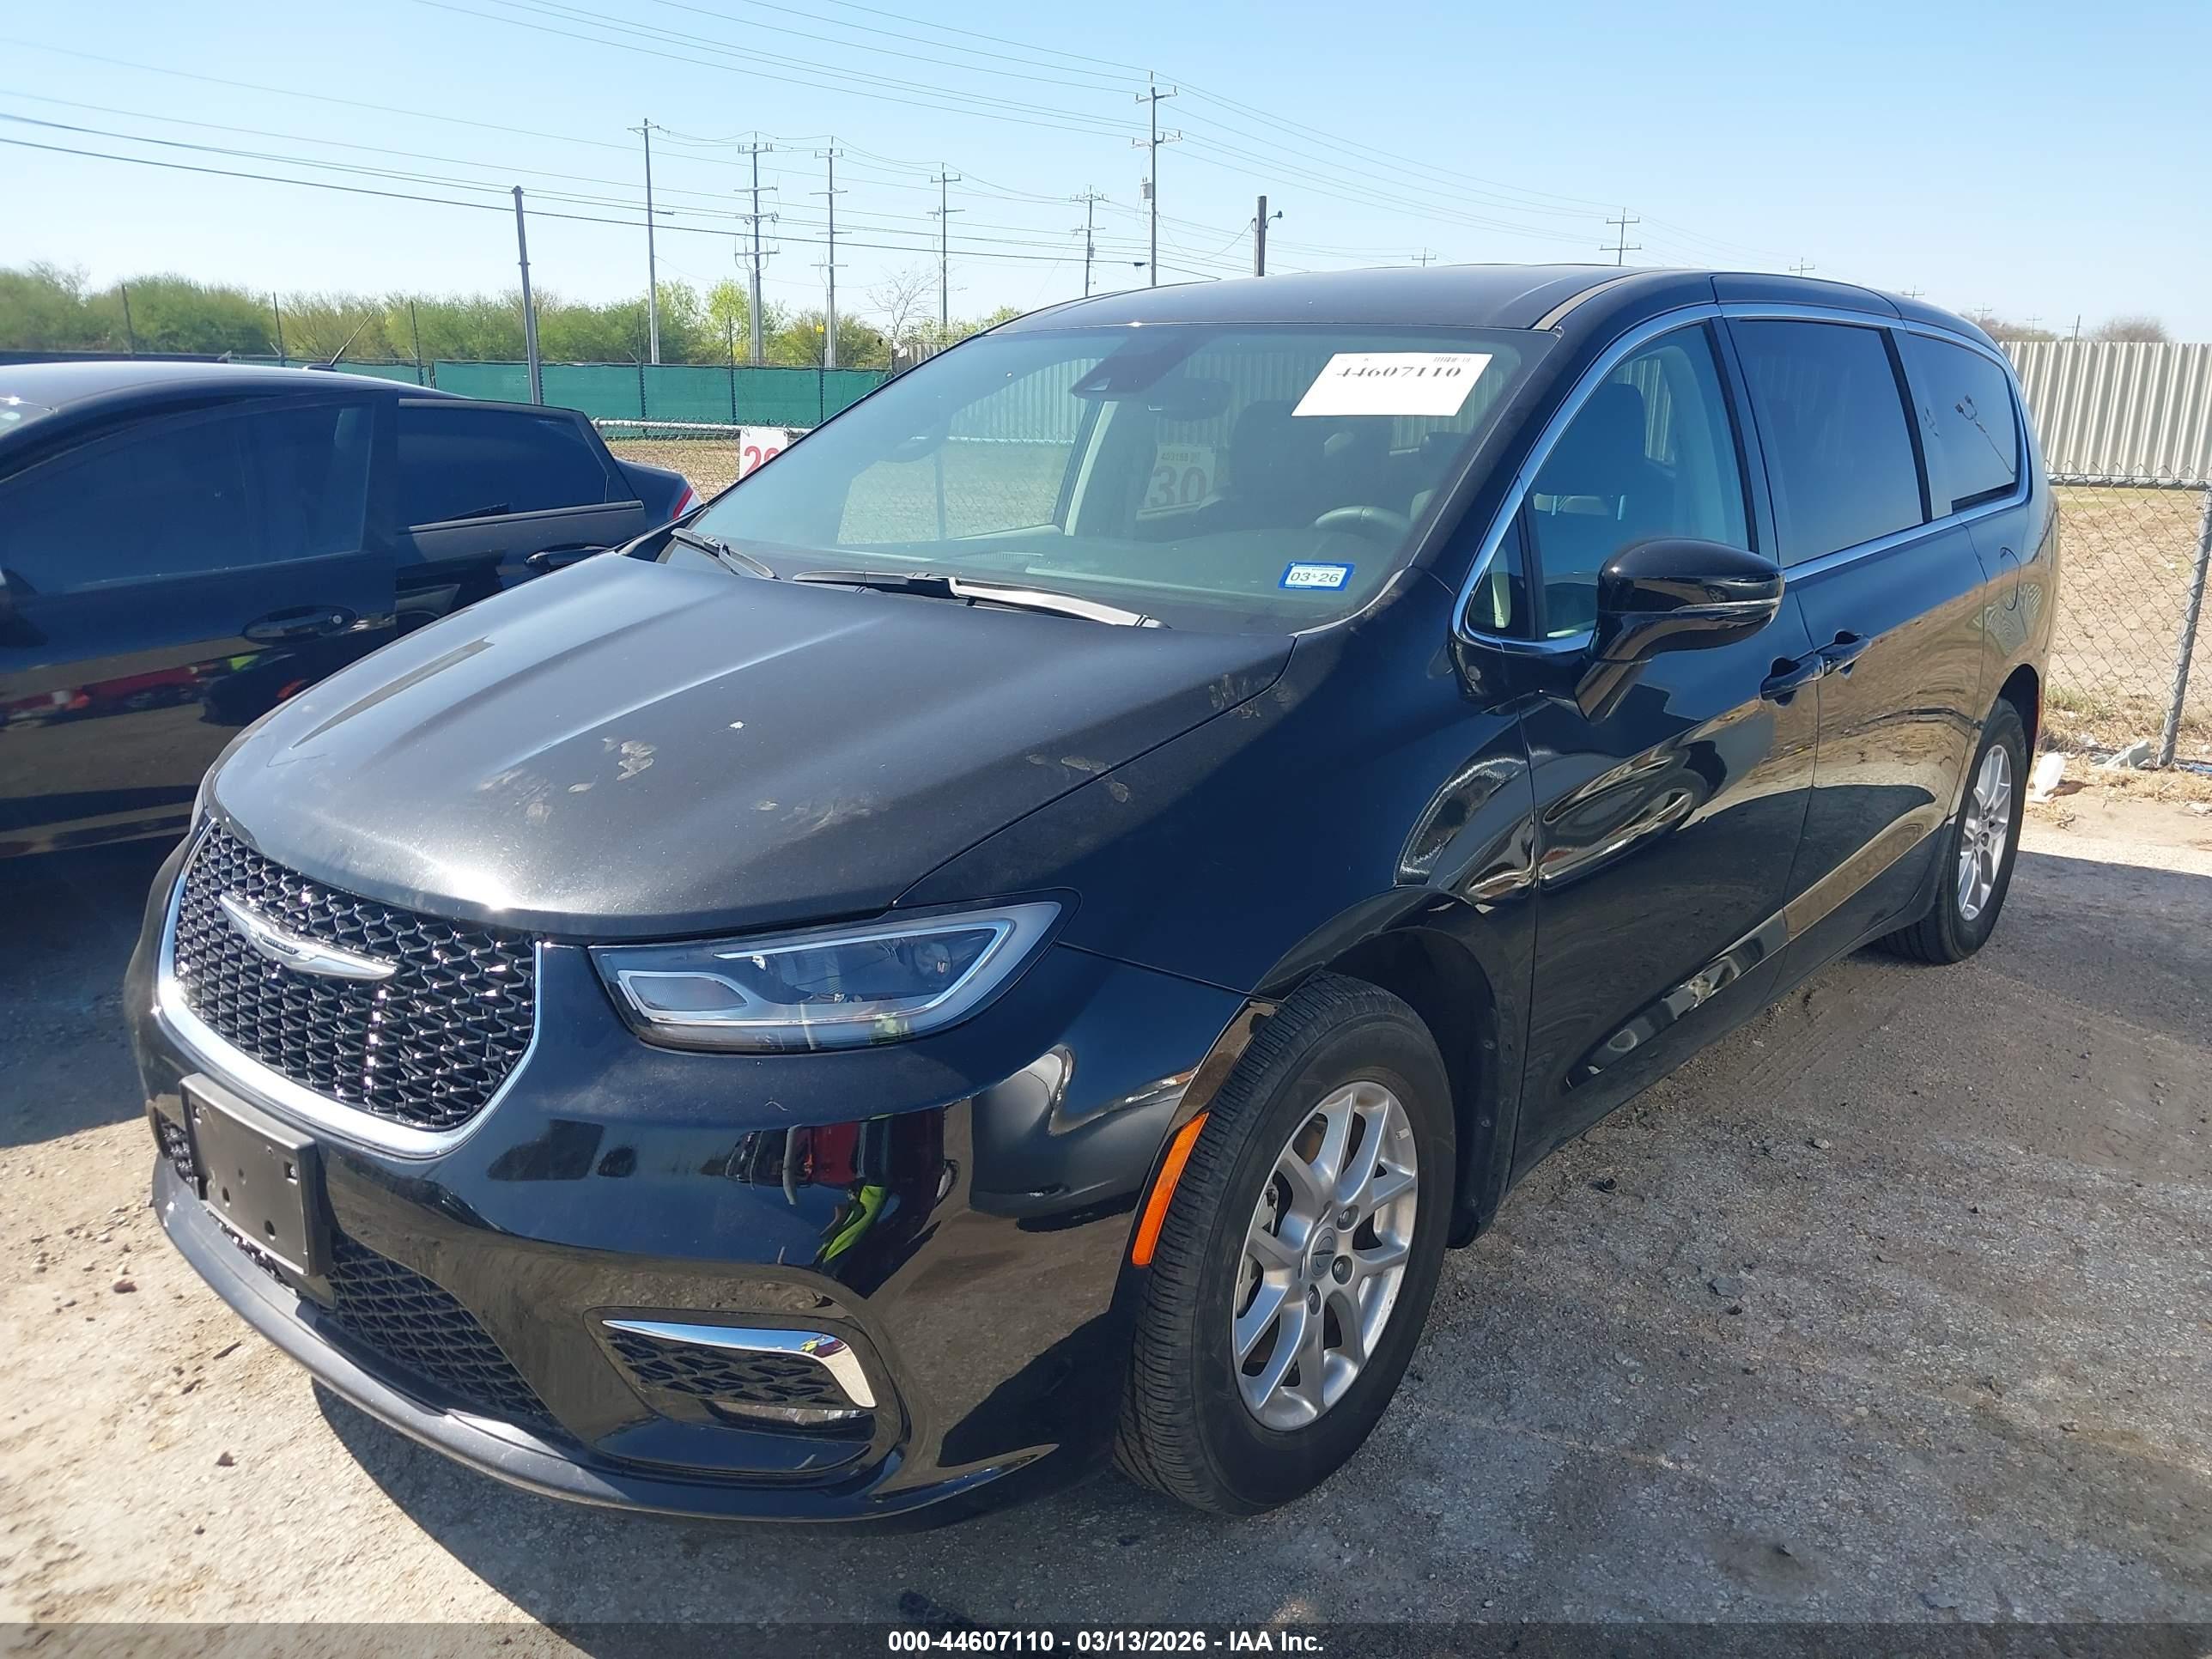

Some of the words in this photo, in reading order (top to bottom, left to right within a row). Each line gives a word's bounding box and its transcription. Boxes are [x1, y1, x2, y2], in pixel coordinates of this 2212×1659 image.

[1336, 367, 1462, 378] 44607110
[1149, 465, 1206, 507] 30
[1290, 572, 1310, 582] 03
[1317, 573, 1340, 583] 26
